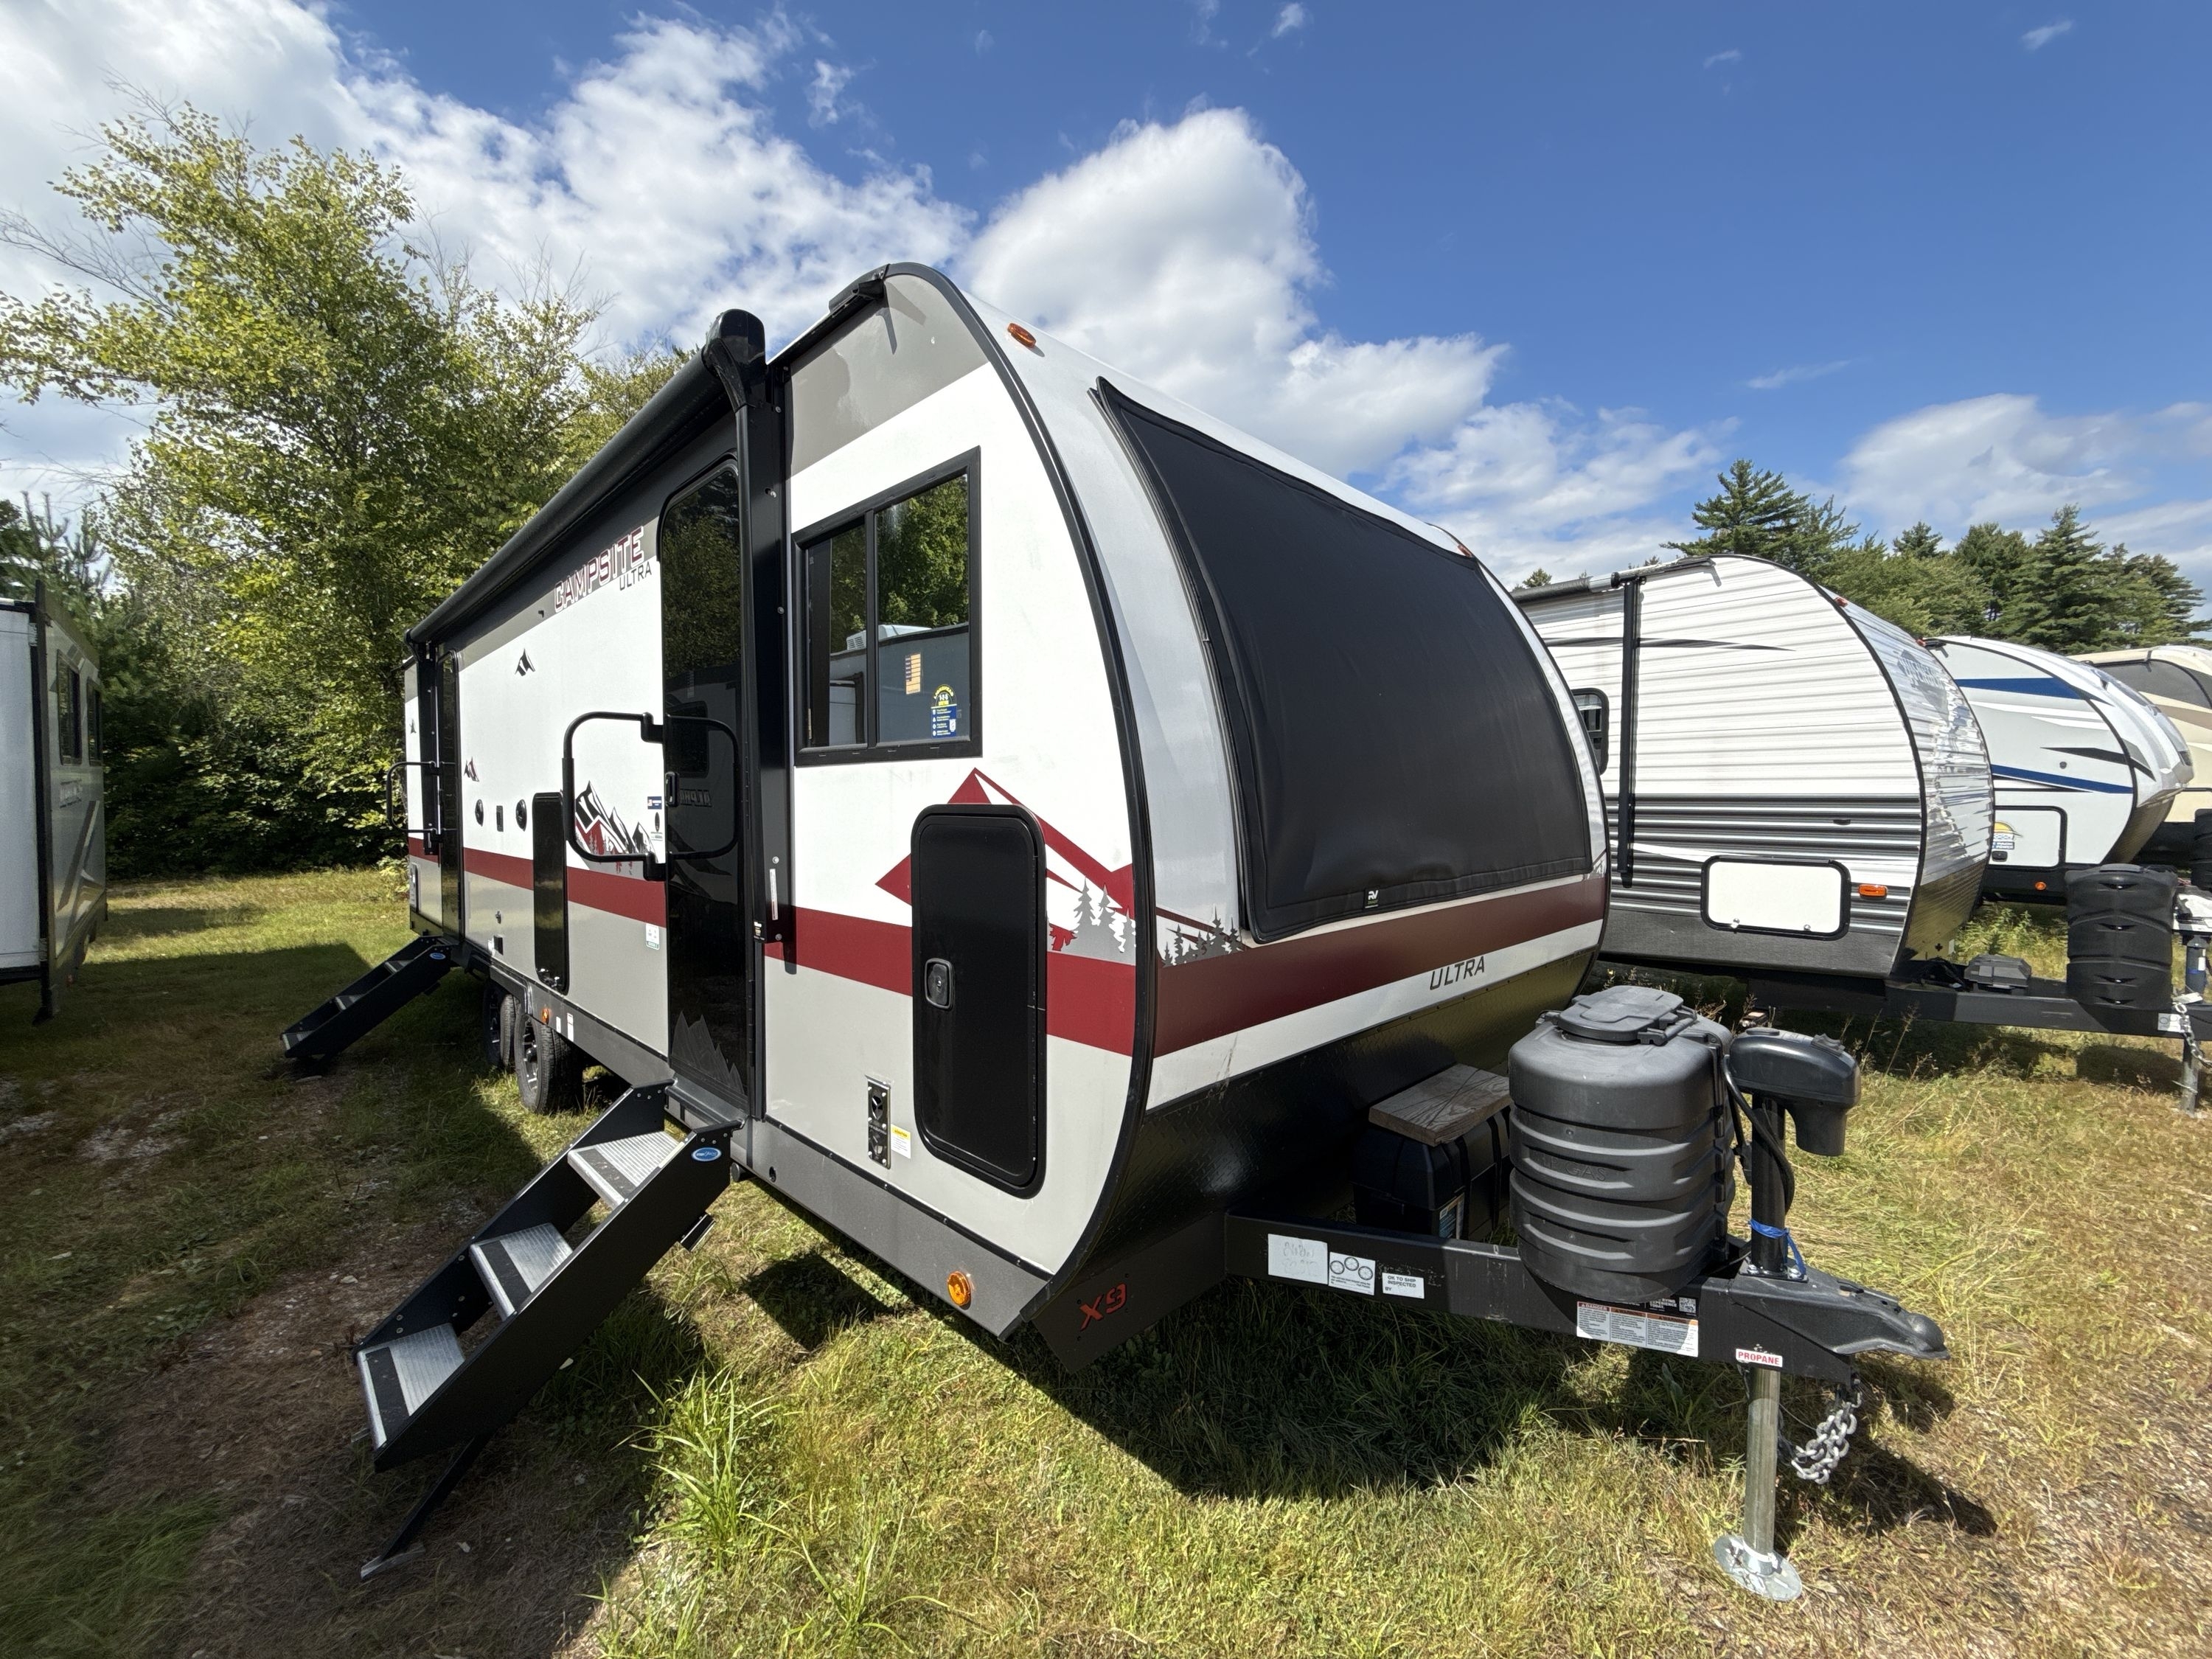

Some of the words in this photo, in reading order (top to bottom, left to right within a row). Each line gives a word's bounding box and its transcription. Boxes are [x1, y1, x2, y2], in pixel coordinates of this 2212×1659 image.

[554, 526, 644, 613] CAMPSITE
[619, 561, 653, 591] ULTRA
[1368, 889, 1379, 900] RV
[1430, 956, 1485, 990] ULTRA
[1565, 1162, 1606, 1181] GAS
[1387, 1280, 1416, 1288] INSPECTED
[1738, 1351, 1780, 1365] PROPANE
